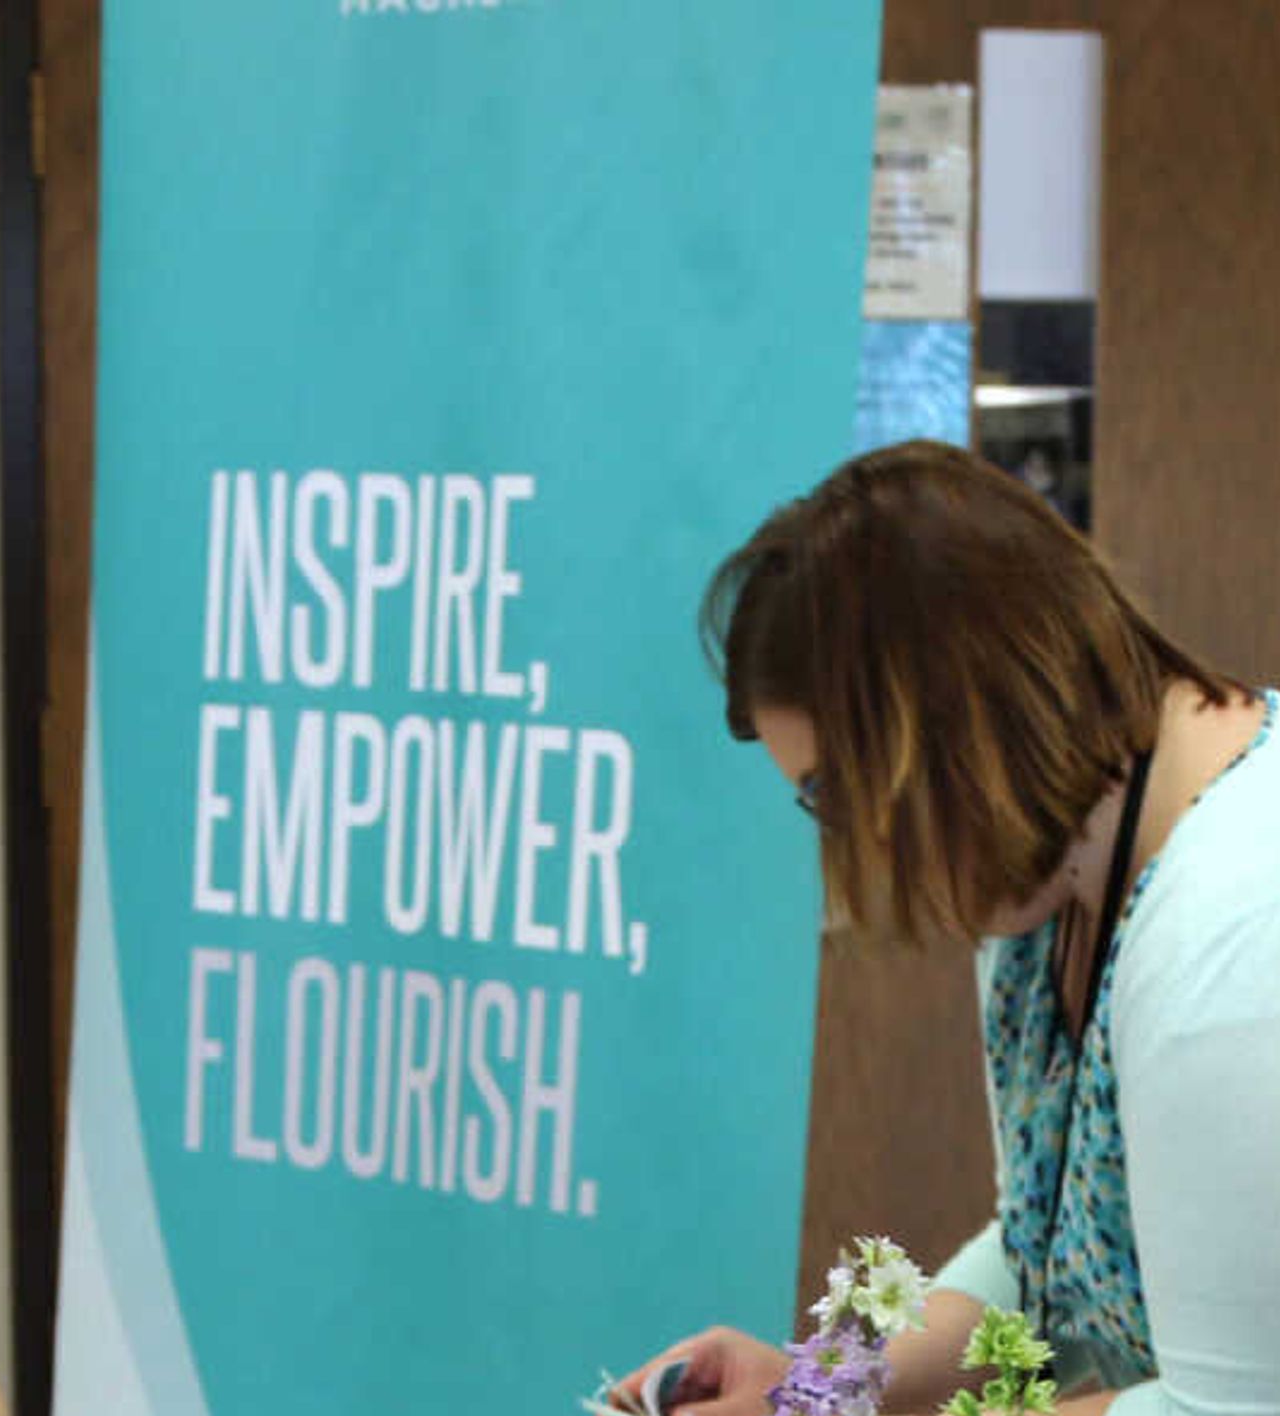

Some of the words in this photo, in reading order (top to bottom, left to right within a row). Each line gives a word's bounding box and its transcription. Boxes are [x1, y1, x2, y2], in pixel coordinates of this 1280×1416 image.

[203, 470, 548, 713] INSPIRE,
[192, 703, 648, 975] EMPOWER,
[184, 947, 598, 1218] FLOURISH.
